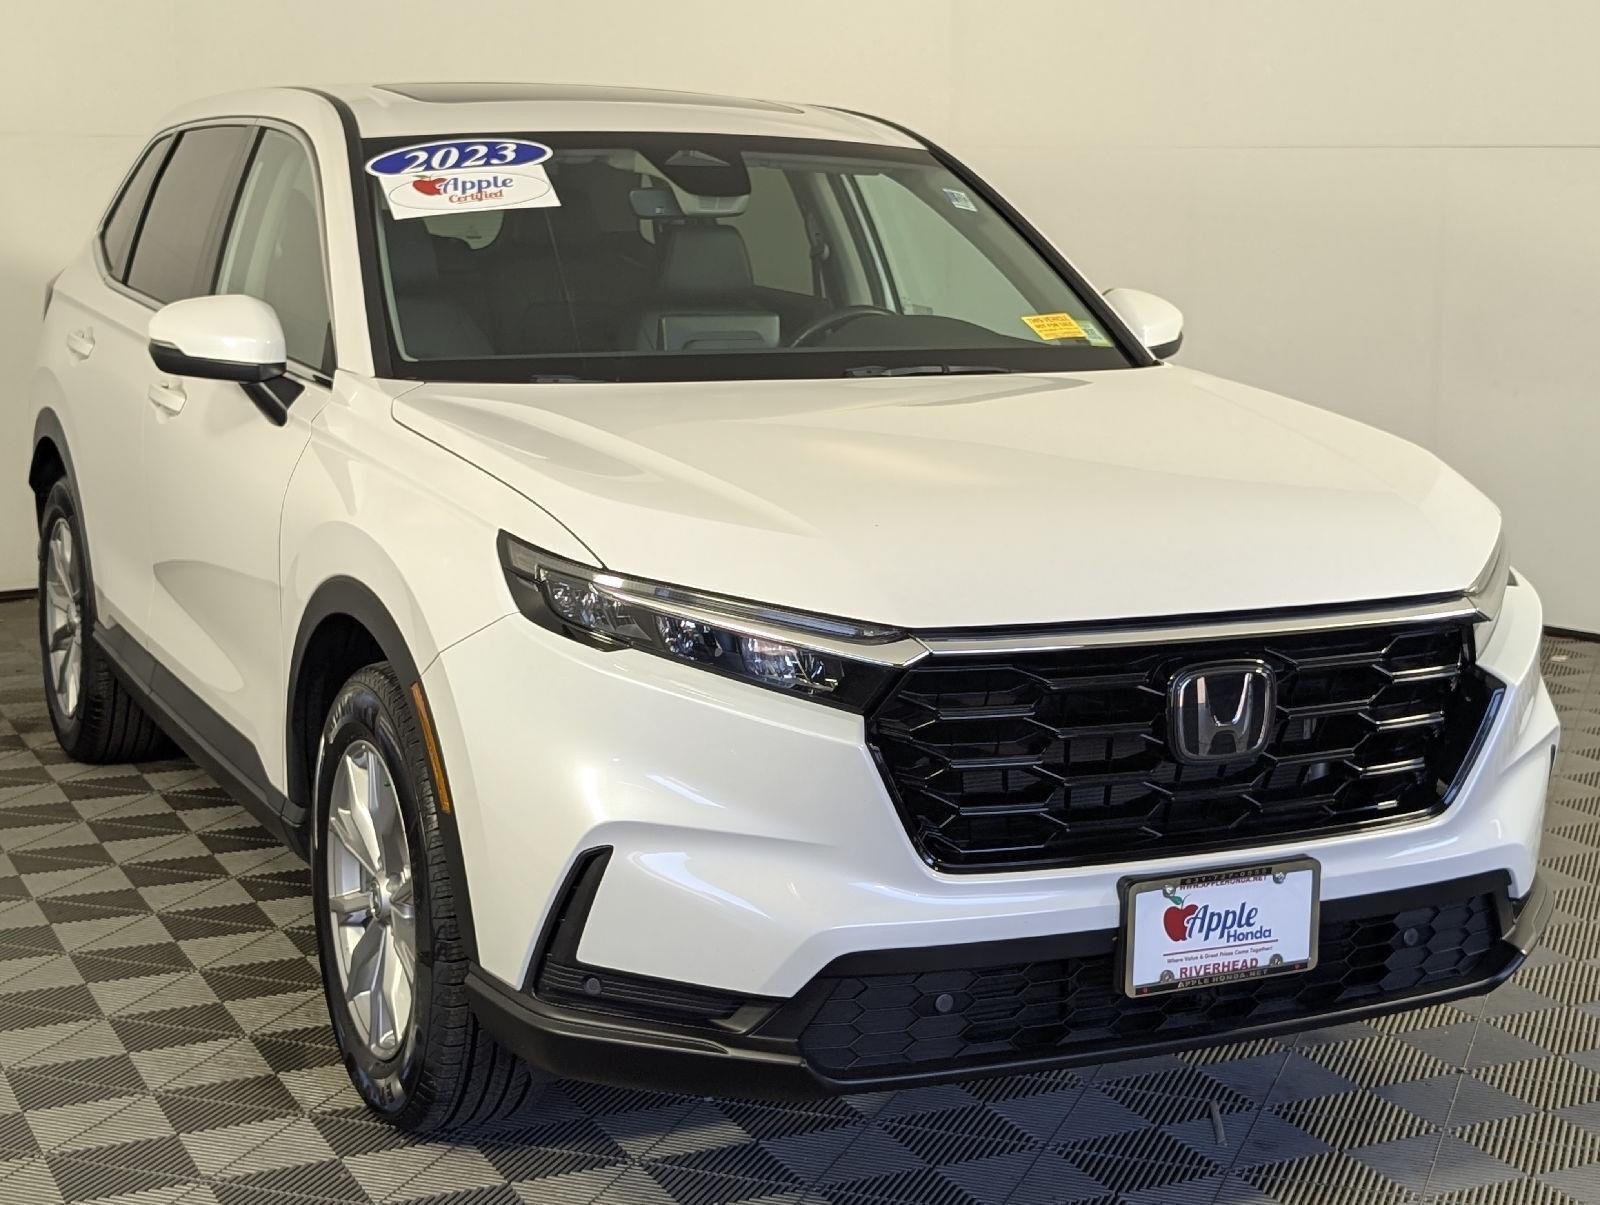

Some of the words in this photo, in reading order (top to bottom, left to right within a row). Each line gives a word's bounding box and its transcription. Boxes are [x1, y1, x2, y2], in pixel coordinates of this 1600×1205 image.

[400, 143, 517, 174] 2023
[442, 176, 513, 195] Apple
[448, 189, 504, 204] Certified
[1185, 902, 1258, 941] Apple
[1226, 926, 1271, 942] Honda
[1179, 958, 1259, 978] RIVERHEAD
[1177, 976, 1210, 989] APPLE
